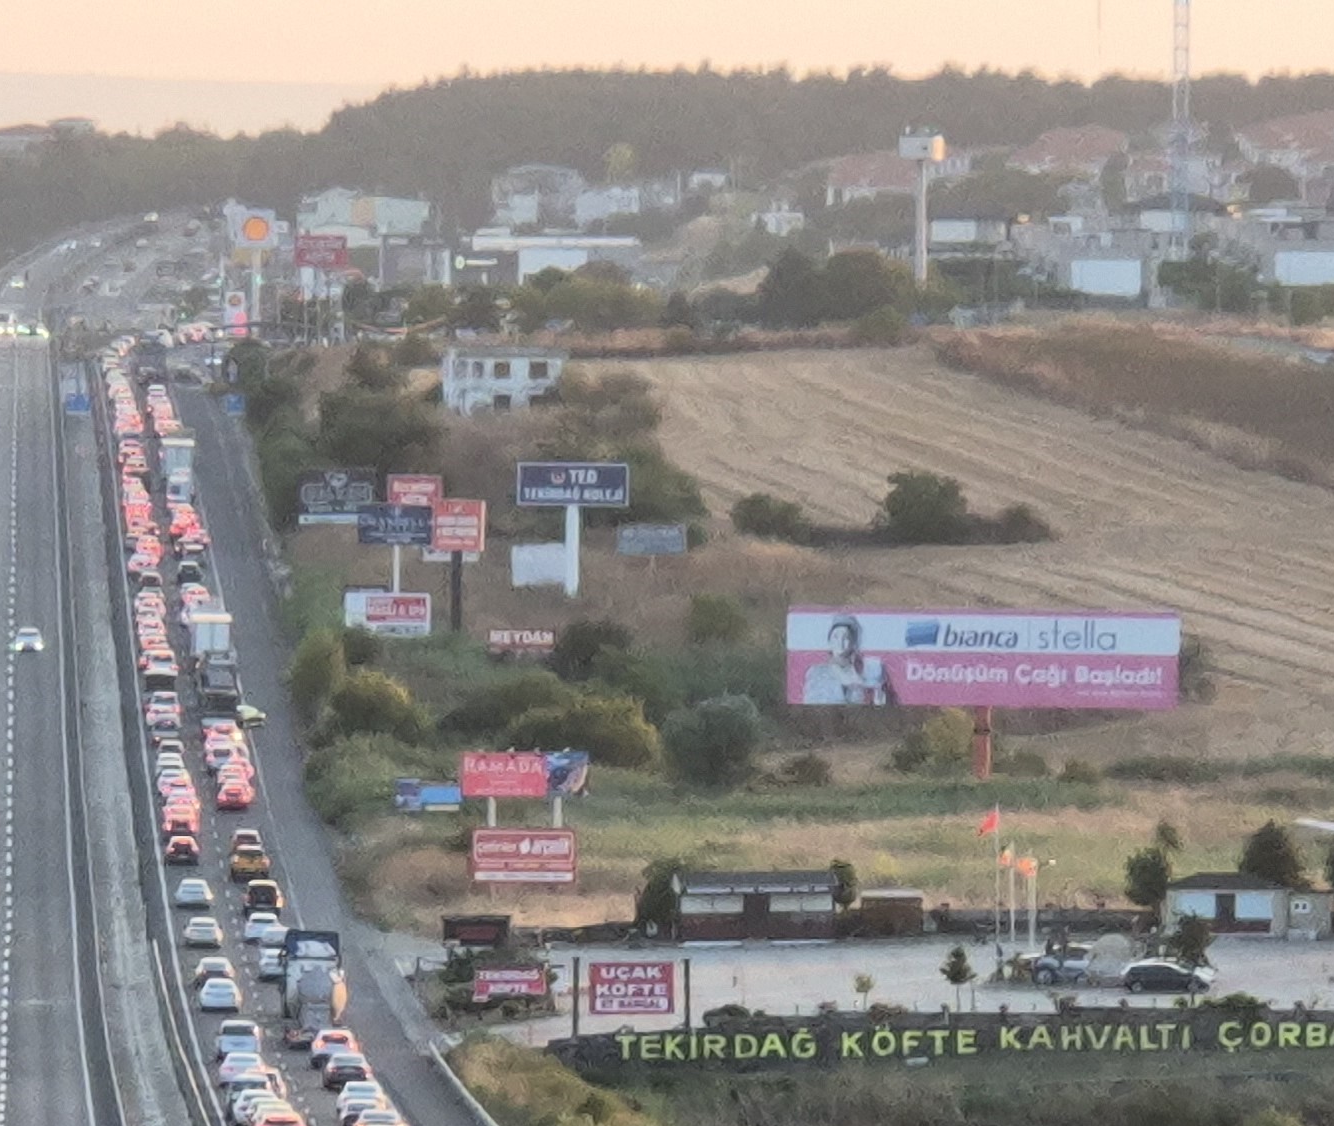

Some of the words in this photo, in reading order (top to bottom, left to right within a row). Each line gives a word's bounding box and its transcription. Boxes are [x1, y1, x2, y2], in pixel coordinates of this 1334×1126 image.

[568, 470, 598, 484] TED
[943, 623, 1019, 648] bianca
[1038, 619, 1117, 651] stella
[906, 659, 1009, 686] Dönüşüm
[1015, 664, 1067, 688] Çağı
[463, 755, 543, 773] RAMADA
[600, 966, 662, 981] UÇAK
[615, 1027, 817, 1060] TEKİRDAĞ
[841, 1023, 978, 1057] KÖFTE
[999, 1022, 1192, 1051] KAHVALTI
